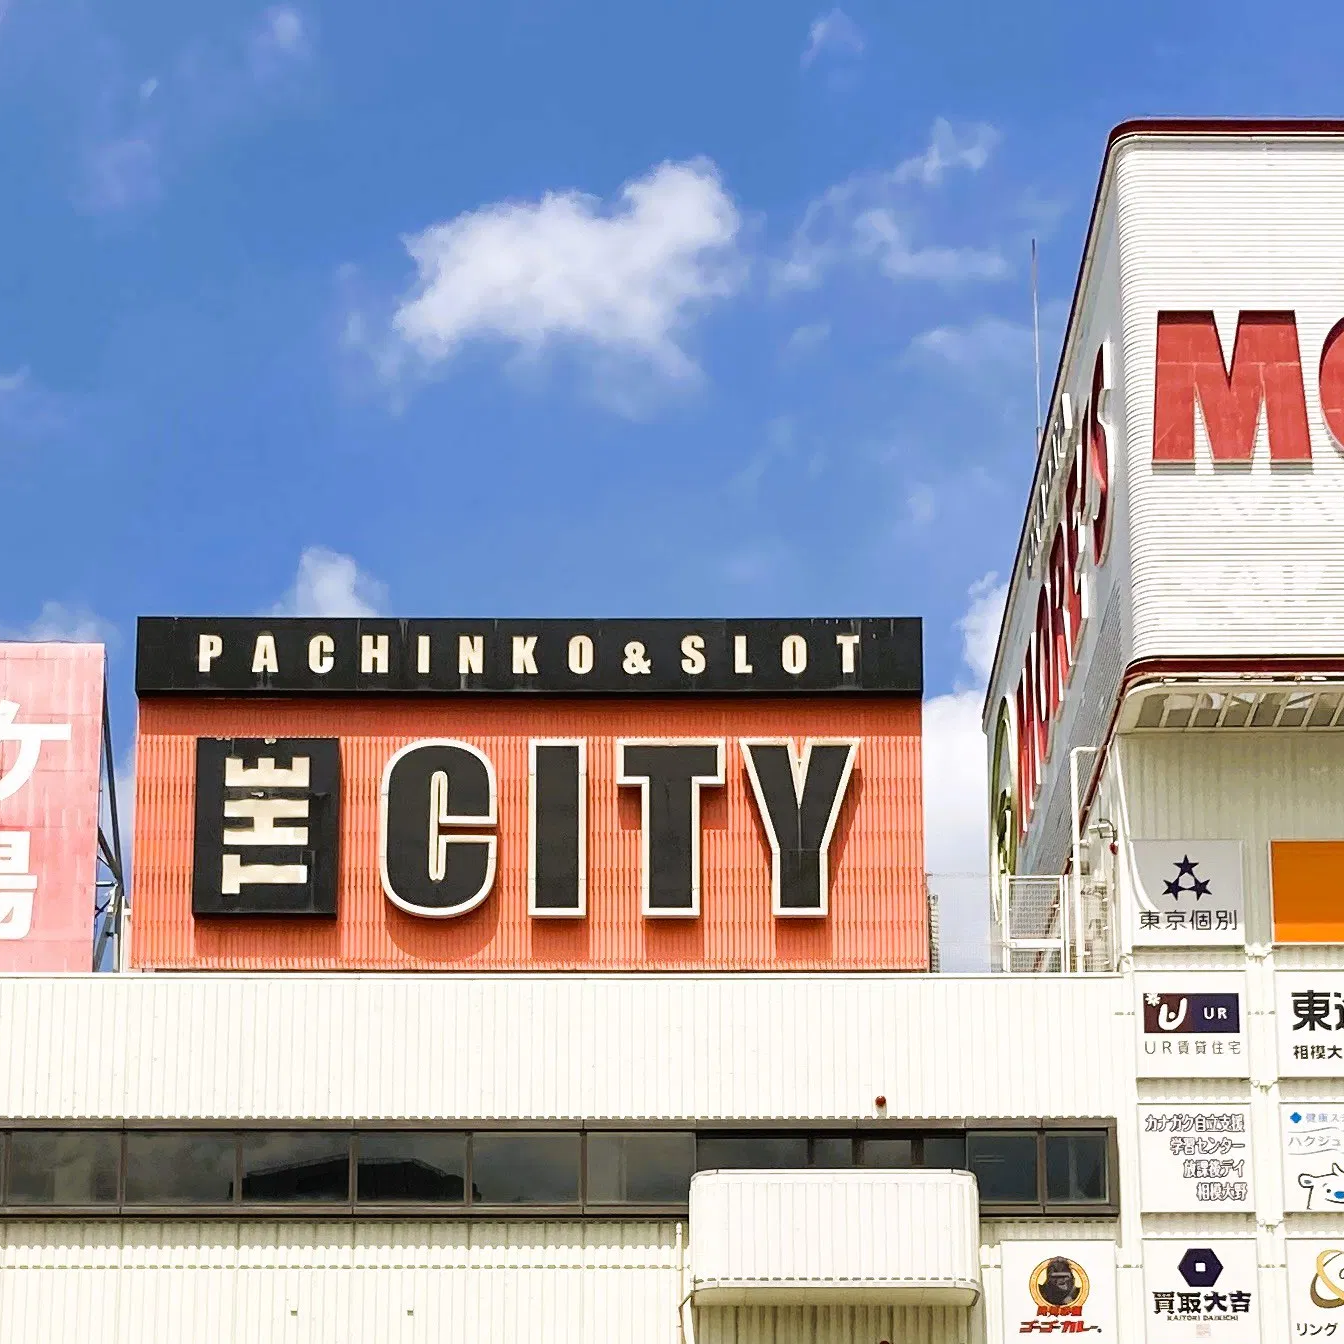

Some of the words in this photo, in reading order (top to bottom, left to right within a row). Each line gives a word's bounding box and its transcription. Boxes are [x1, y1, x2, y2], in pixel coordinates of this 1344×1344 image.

[222, 755, 311, 895] THE
[379, 737, 862, 919] CITY
[1139, 908, 1238, 931] 東京個別
[1203, 1006, 1228, 1020] UR
[1144, 1040, 1241, 1055] UR賃貸住宅
[1145, 1113, 1245, 1133] カナガク自立支援
[1169, 1137, 1246, 1155] 学習センター
[1183, 1159, 1246, 1179] 放課後デイ
[1196, 1182, 1248, 1201] 相模大野
[1152, 1290, 1252, 1315] 買取大吉
[1019, 1319, 1099, 1334] ゴーゴーカレー
[1296, 1323, 1337, 1337] リング
